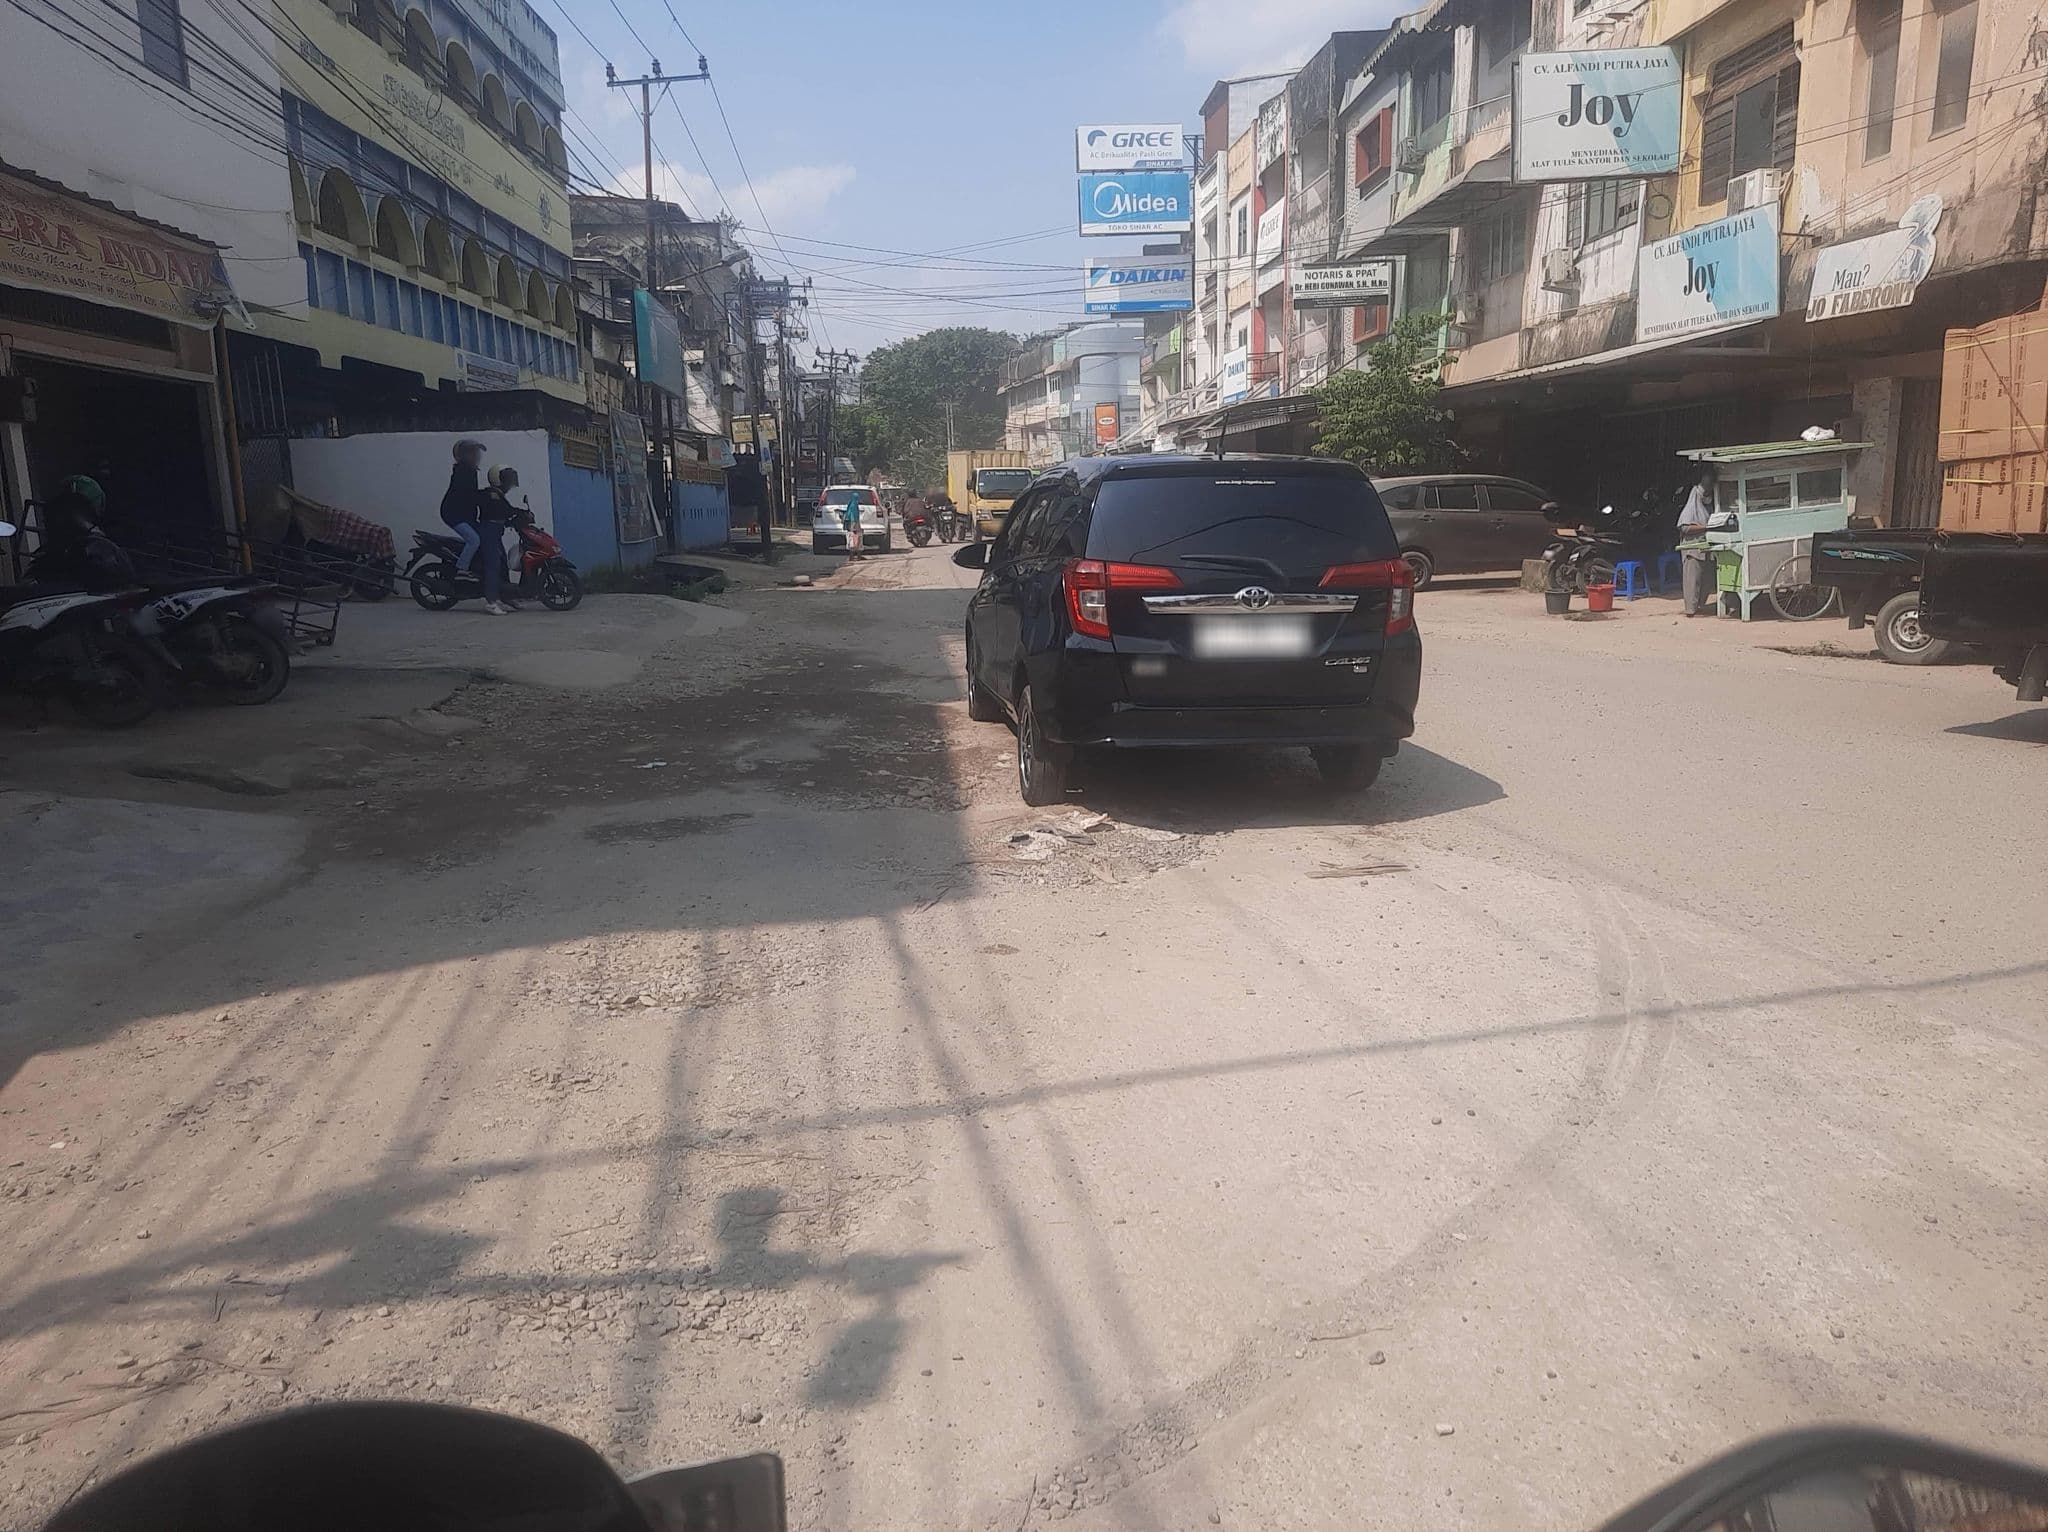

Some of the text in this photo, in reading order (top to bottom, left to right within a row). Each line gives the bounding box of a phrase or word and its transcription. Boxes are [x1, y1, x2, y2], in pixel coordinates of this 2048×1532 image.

[1534, 58, 1669, 75] CV. ALFANDI PUTRA JAYA
[1557, 83, 1644, 138] Joy
[1112, 131, 1175, 148] GREE
[1530, 153, 1670, 169] ALAT TULIS KANTOR DAN SEKOLAH
[1571, 148, 1630, 158] MENYEDIAKAN
[1103, 188, 1178, 216] Midea
[1654, 216, 1755, 260] CV. ALFANDI PUTRA JAYA
[1110, 268, 1186, 284] DAIKIN
[1304, 268, 1377, 280] NOTARIS & PPAT
[1683, 257, 1720, 303] Joy
[1832, 263, 1871, 292] Mau?
[1807, 296, 1827, 320] JO
[1998, 460, 2007, 496] MASPON
